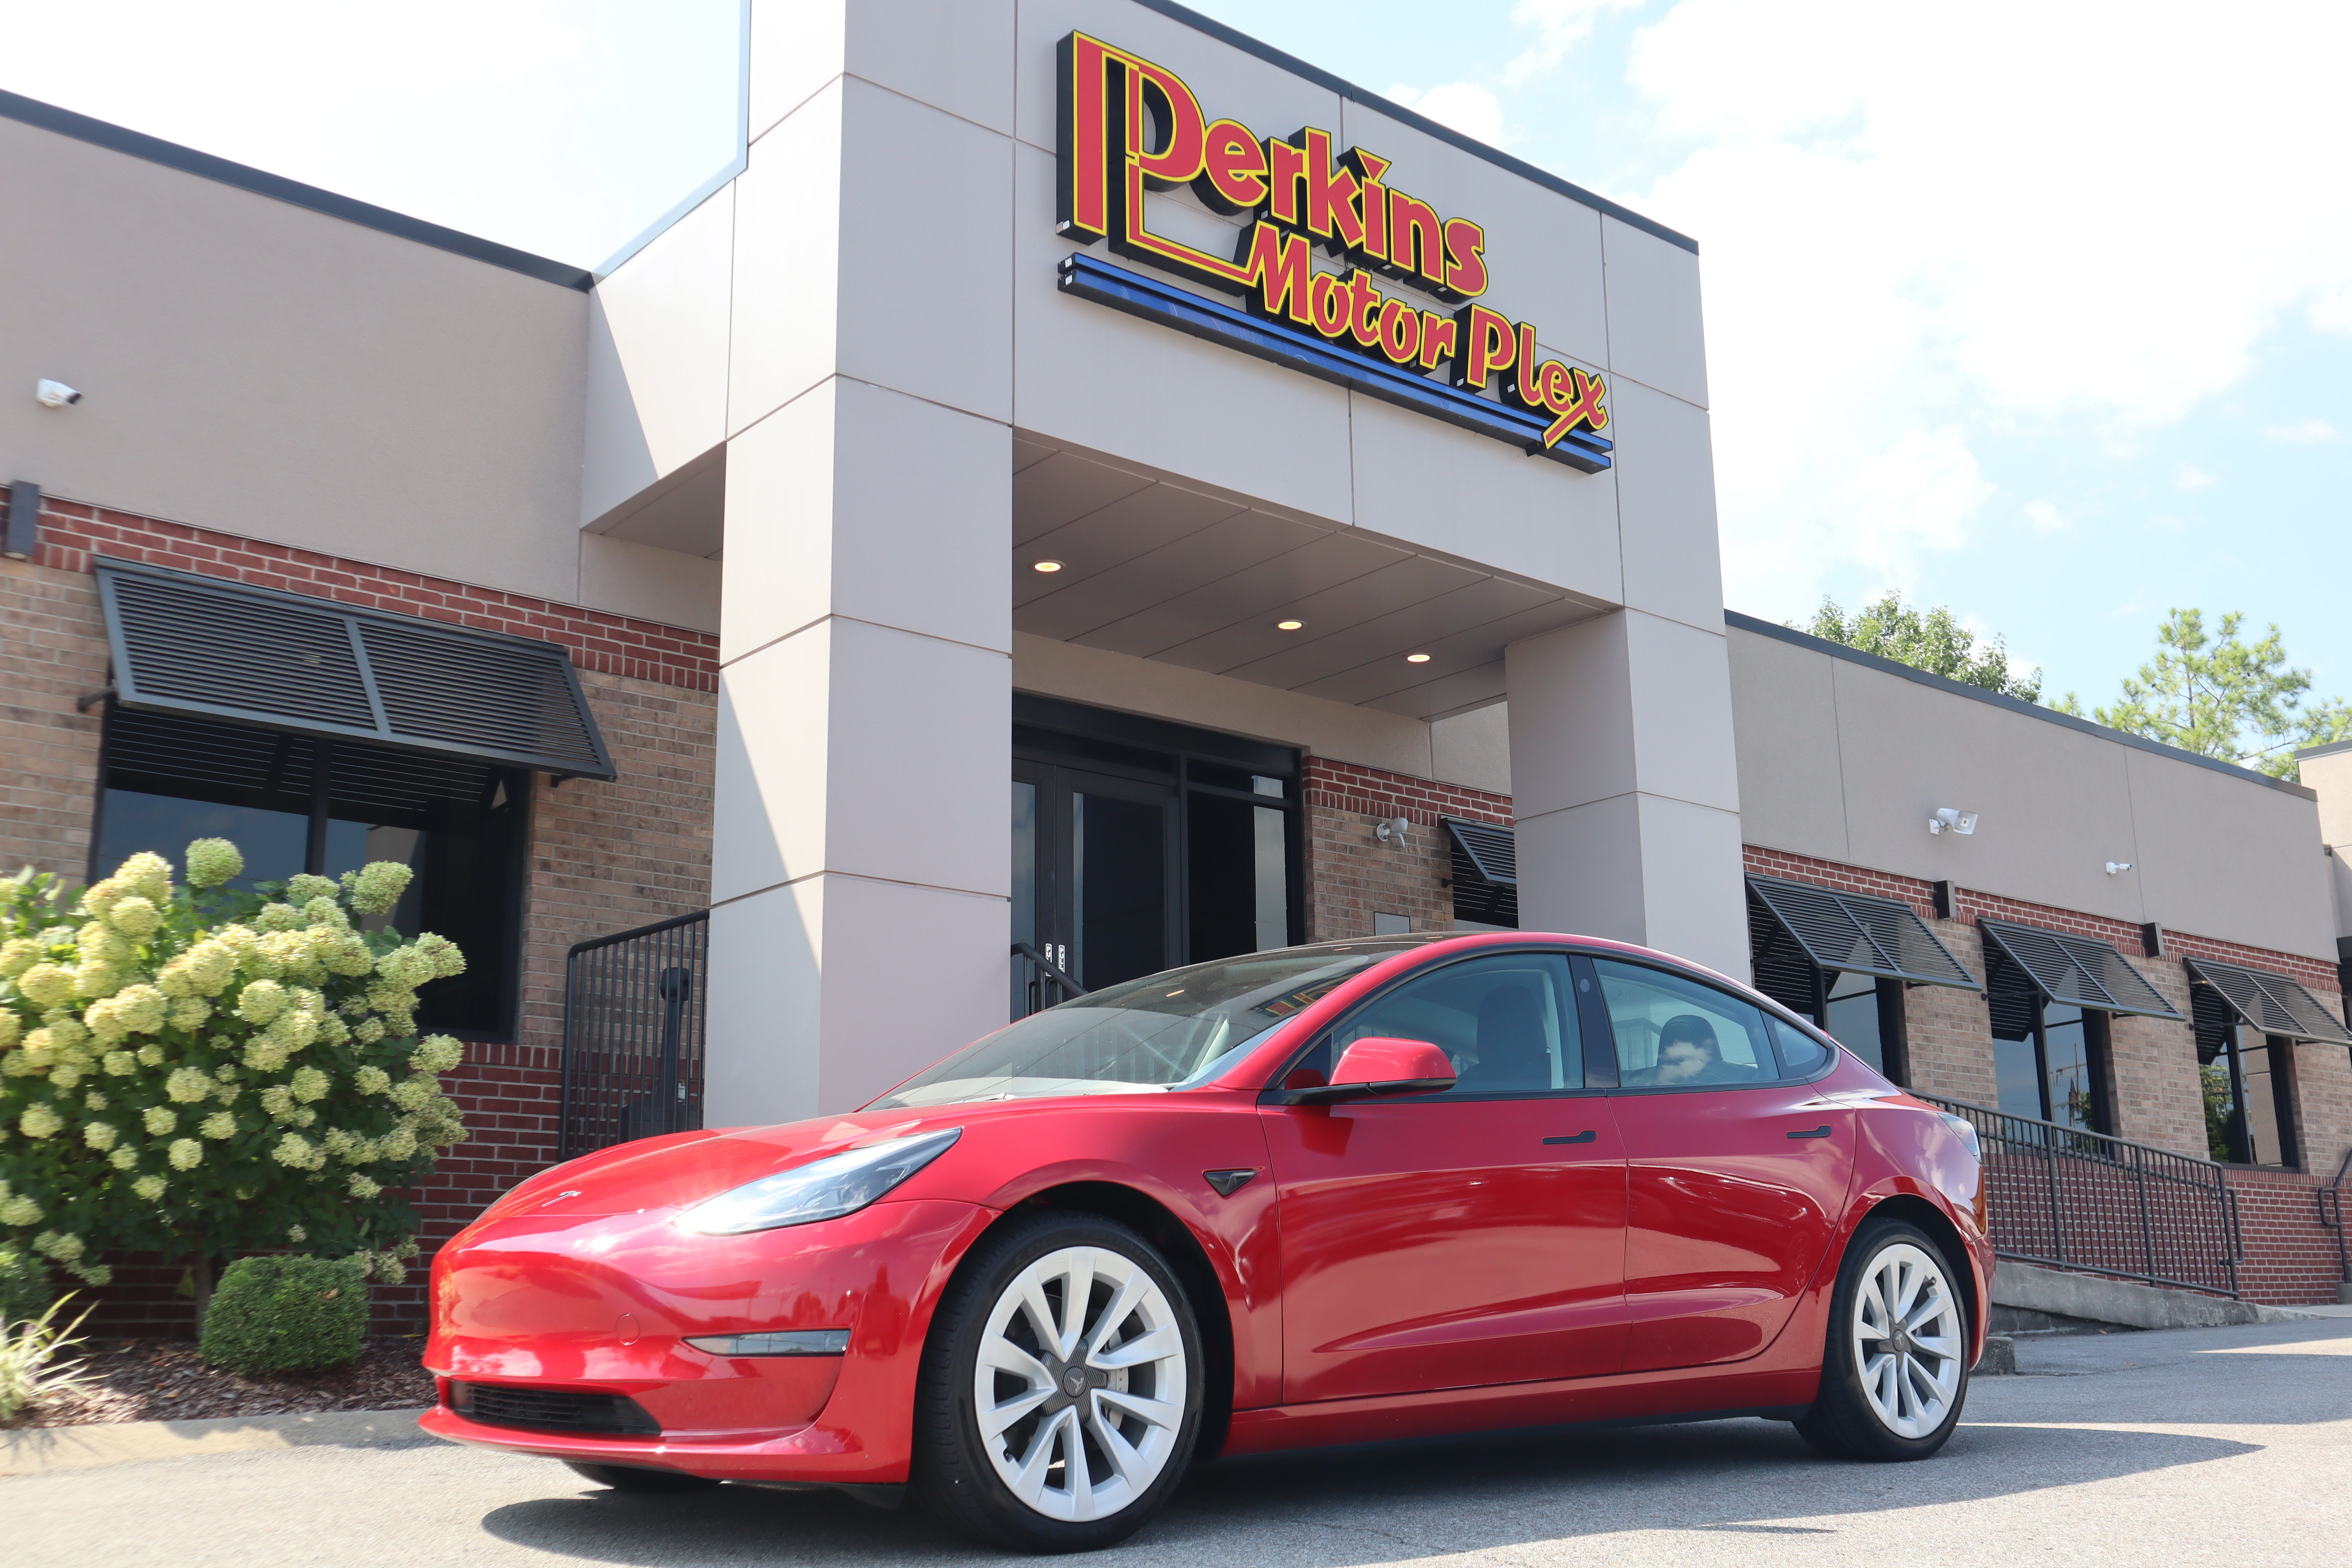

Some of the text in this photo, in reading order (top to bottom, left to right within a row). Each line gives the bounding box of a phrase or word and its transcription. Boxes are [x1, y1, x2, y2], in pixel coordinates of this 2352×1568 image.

[1073, 30, 1488, 296] Perkins
[1248, 219, 1608, 449] Motor Plex
